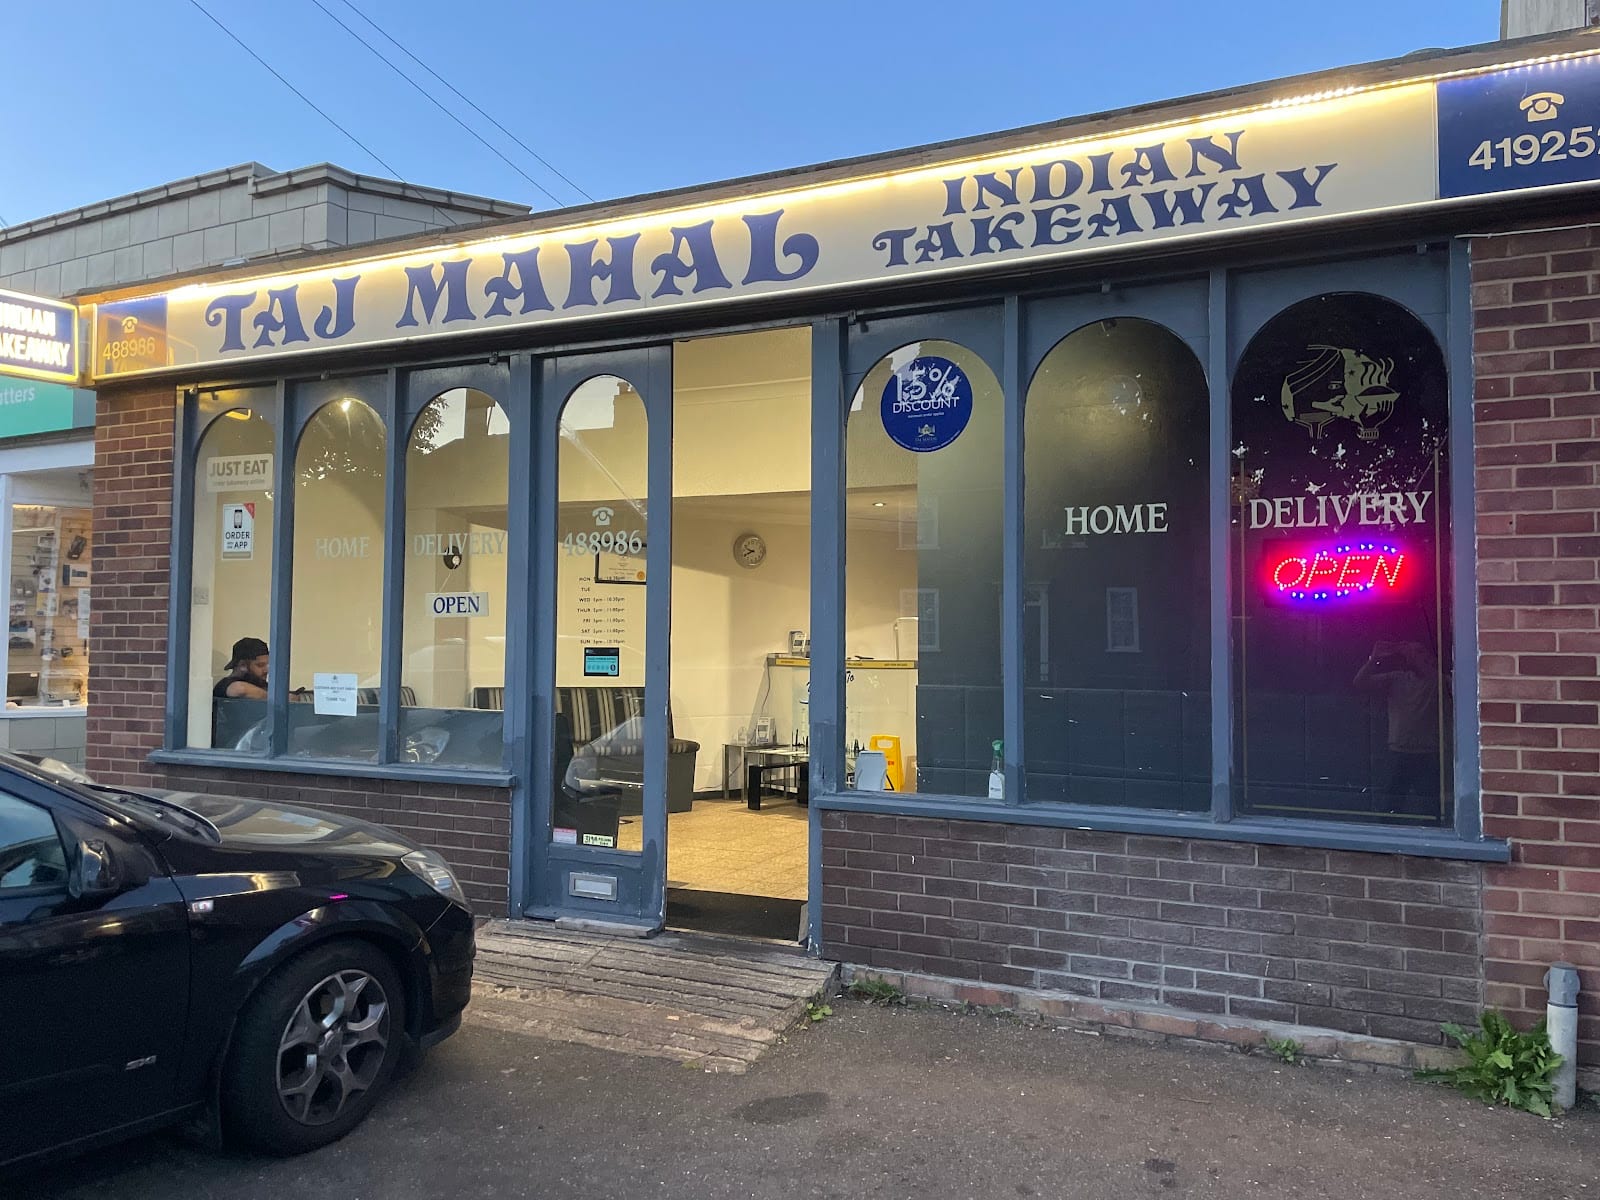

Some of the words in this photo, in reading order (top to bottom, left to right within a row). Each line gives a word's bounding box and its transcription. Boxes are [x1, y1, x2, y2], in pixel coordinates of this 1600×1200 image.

[1468, 126, 1600, 170] 41925
[942, 129, 1245, 217] INDIAN
[873, 163, 1338, 268] TAKEAWAY
[205, 274, 361, 353] TAJ
[395, 208, 820, 329] MAHAL
[103, 337, 156, 361] 488986
[896, 366, 955, 402] 15%
[892, 396, 960, 414] DISCOUNT
[209, 461, 241, 477] JUST
[243, 460, 269, 475] EAT
[1064, 502, 1168, 535] HOME
[1248, 490, 1433, 530] DELIVERY
[225, 531, 250, 540] ORDER
[234, 541, 248, 549] APP
[315, 536, 370, 559] HOME
[413, 532, 506, 557] DELIVERY
[562, 530, 642, 557] 488986
[1273, 554, 1404, 589] OPEN
[433, 596, 480, 614] OPEN
